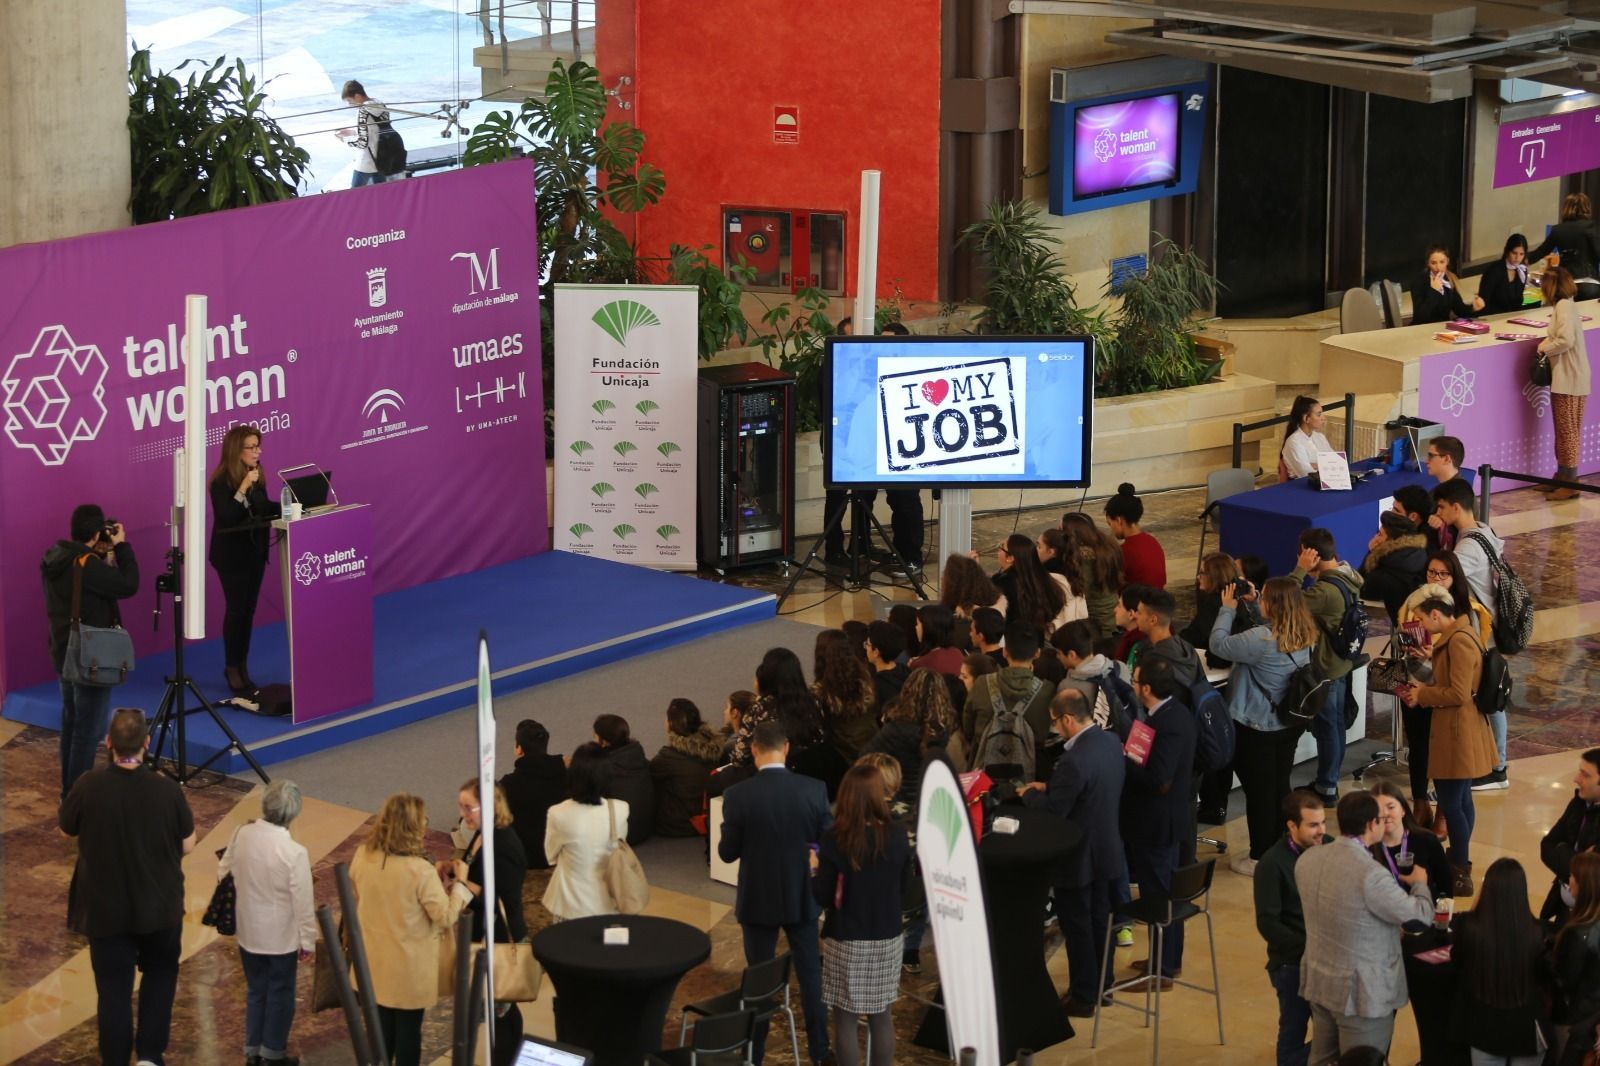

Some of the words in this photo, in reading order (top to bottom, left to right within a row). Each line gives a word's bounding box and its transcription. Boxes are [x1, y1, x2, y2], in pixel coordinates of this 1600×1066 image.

[1120, 129, 1148, 142] talent
[1511, 128, 1534, 138] Entradas
[1536, 123, 1561, 134] Generales
[1120, 141, 1155, 155] woman
[346, 228, 406, 249] Coorganiza
[452, 299, 484, 314] diputación
[484, 297, 493, 306] de
[493, 292, 519, 305] málaga
[354, 309, 404, 328] Ayuntamiento
[361, 330, 371, 338] de
[371, 324, 398, 336] Málaga
[123, 314, 249, 378] talnt
[452, 333, 523, 368] uma.es
[592, 358, 660, 369] Fundación
[602, 374, 650, 389] Unicaja
[901, 383, 921, 410] I
[952, 372, 997, 403] MY
[456, 371, 526, 413] LINK
[228, 410, 290, 434] Eaña
[897, 403, 1008, 459] JOB
[324, 547, 355, 564] talent
[324, 559, 364, 576] woman
